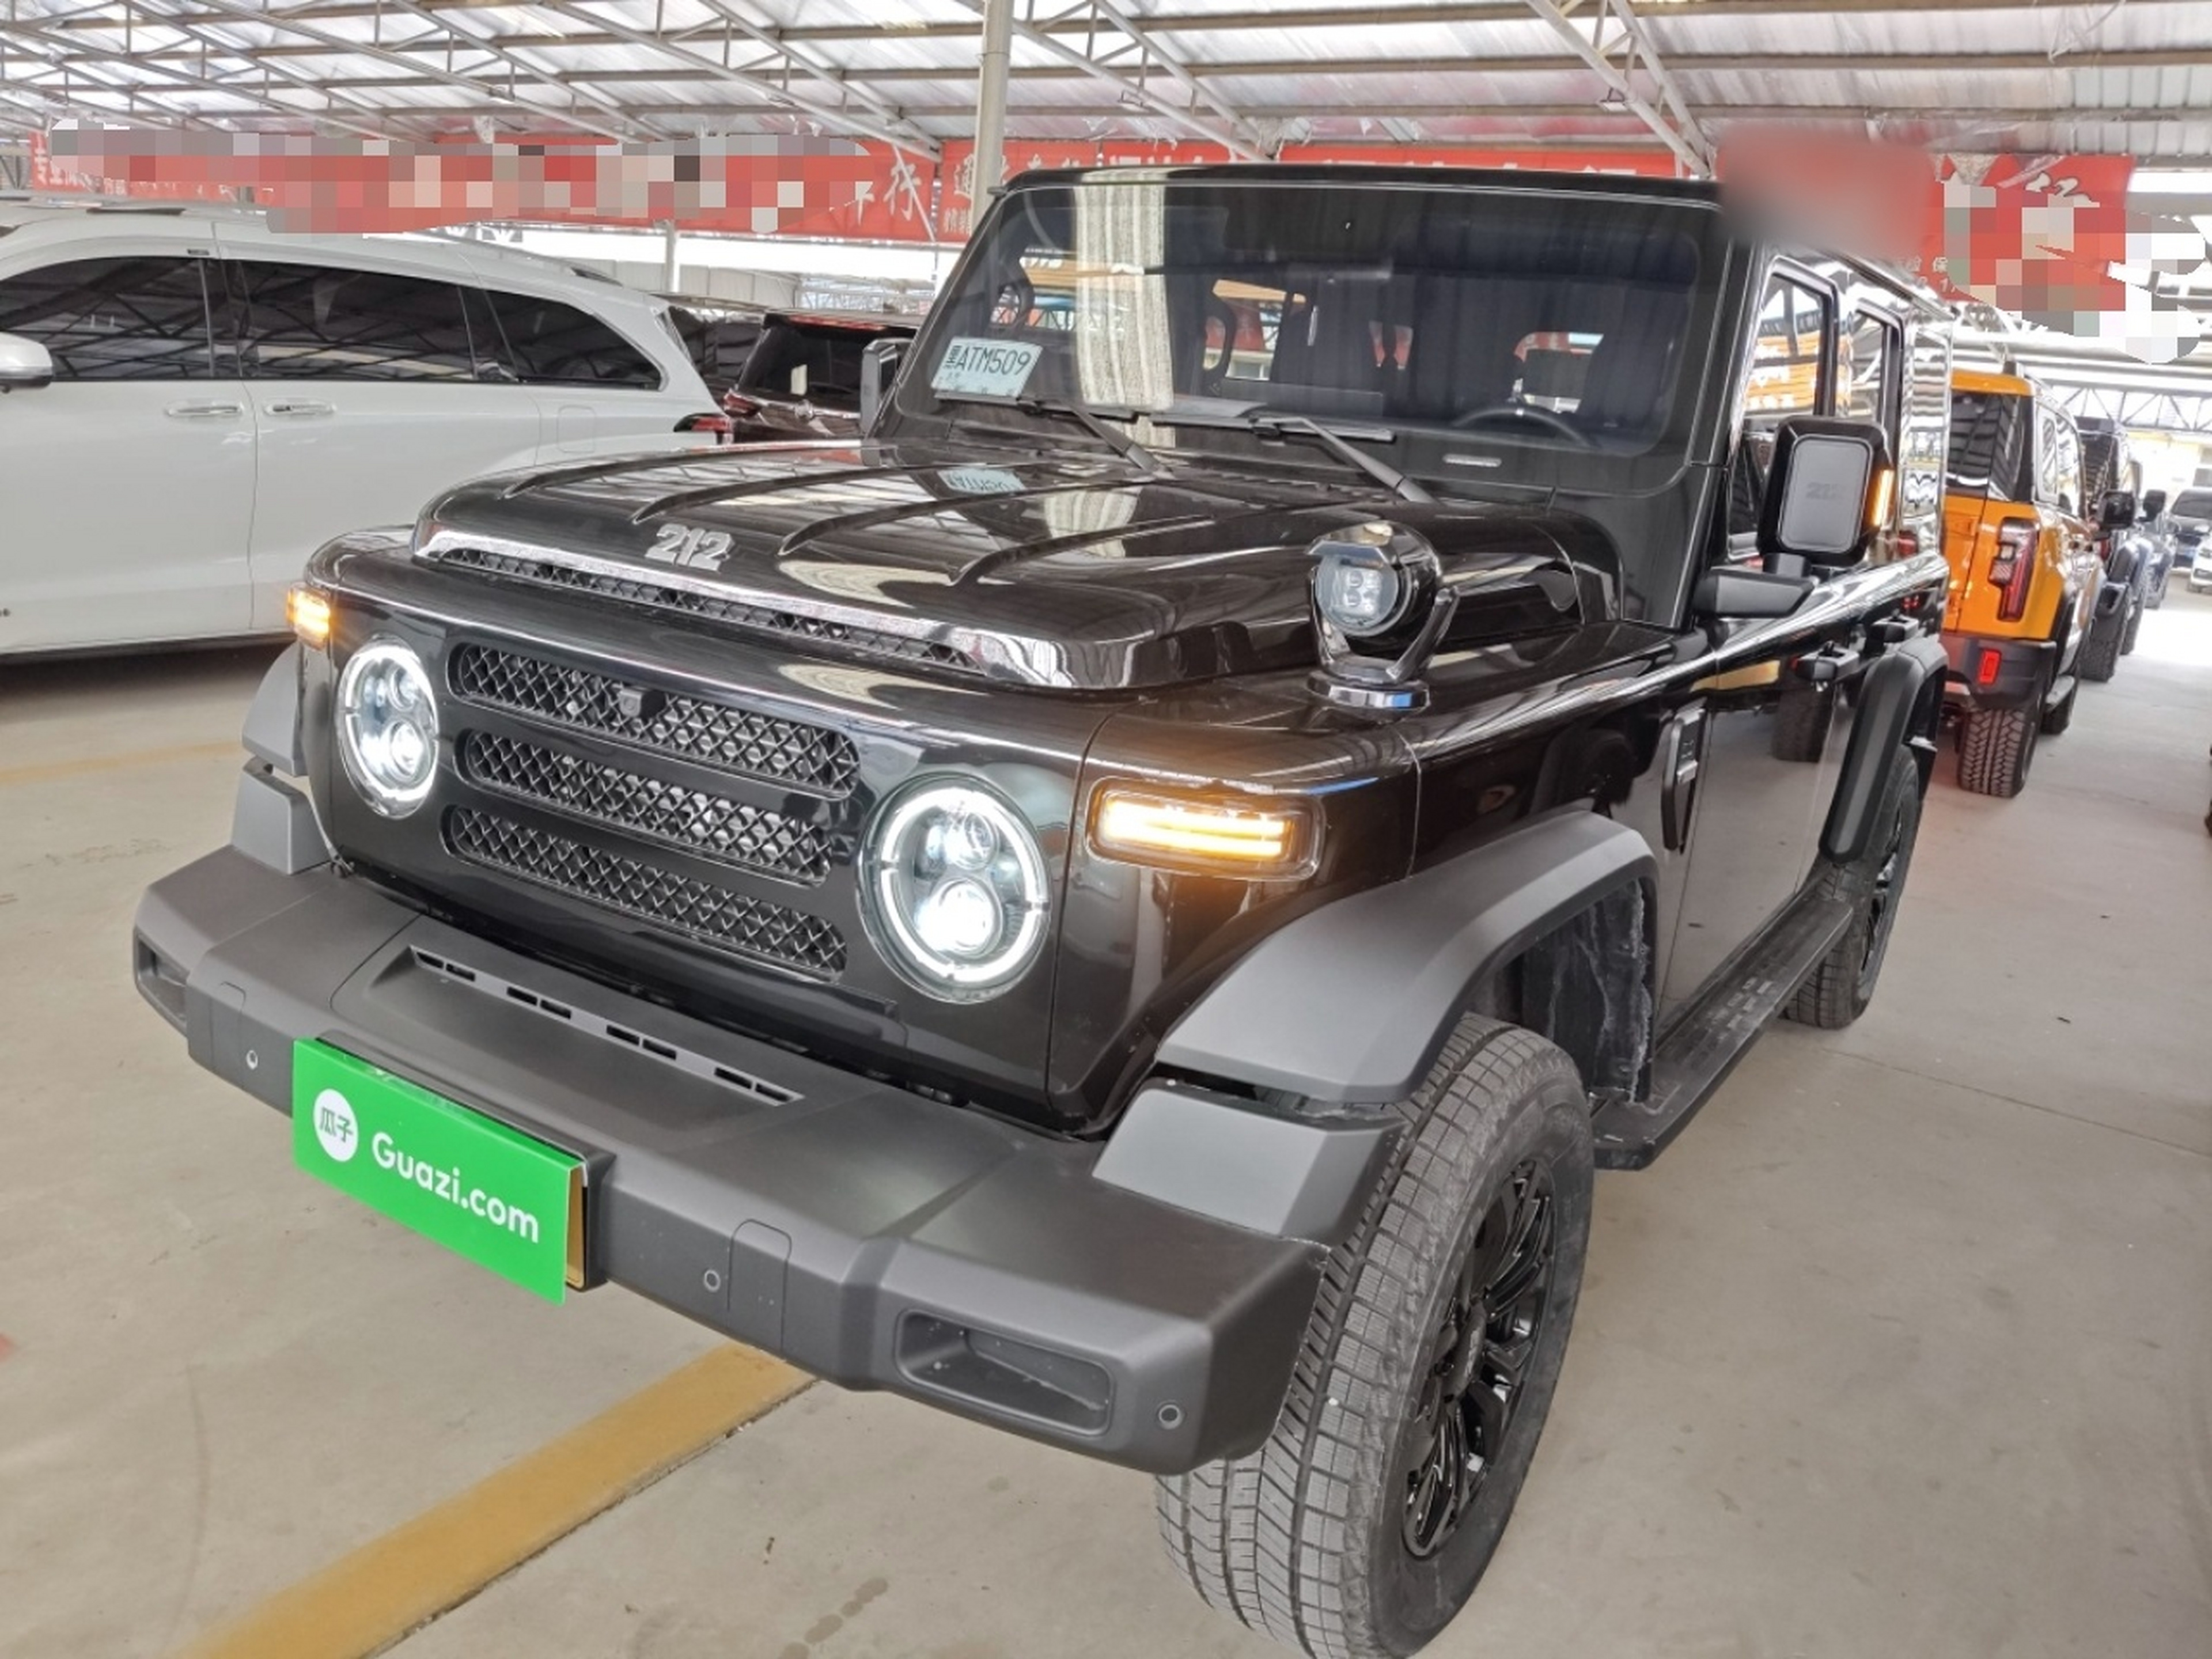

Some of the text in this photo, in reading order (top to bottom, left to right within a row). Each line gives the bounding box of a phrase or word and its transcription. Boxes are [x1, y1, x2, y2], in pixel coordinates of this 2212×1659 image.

[644, 523, 734, 571] 212
[320, 1106, 354, 1143] 瓜子
[372, 1131, 539, 1243] Guazi.com
